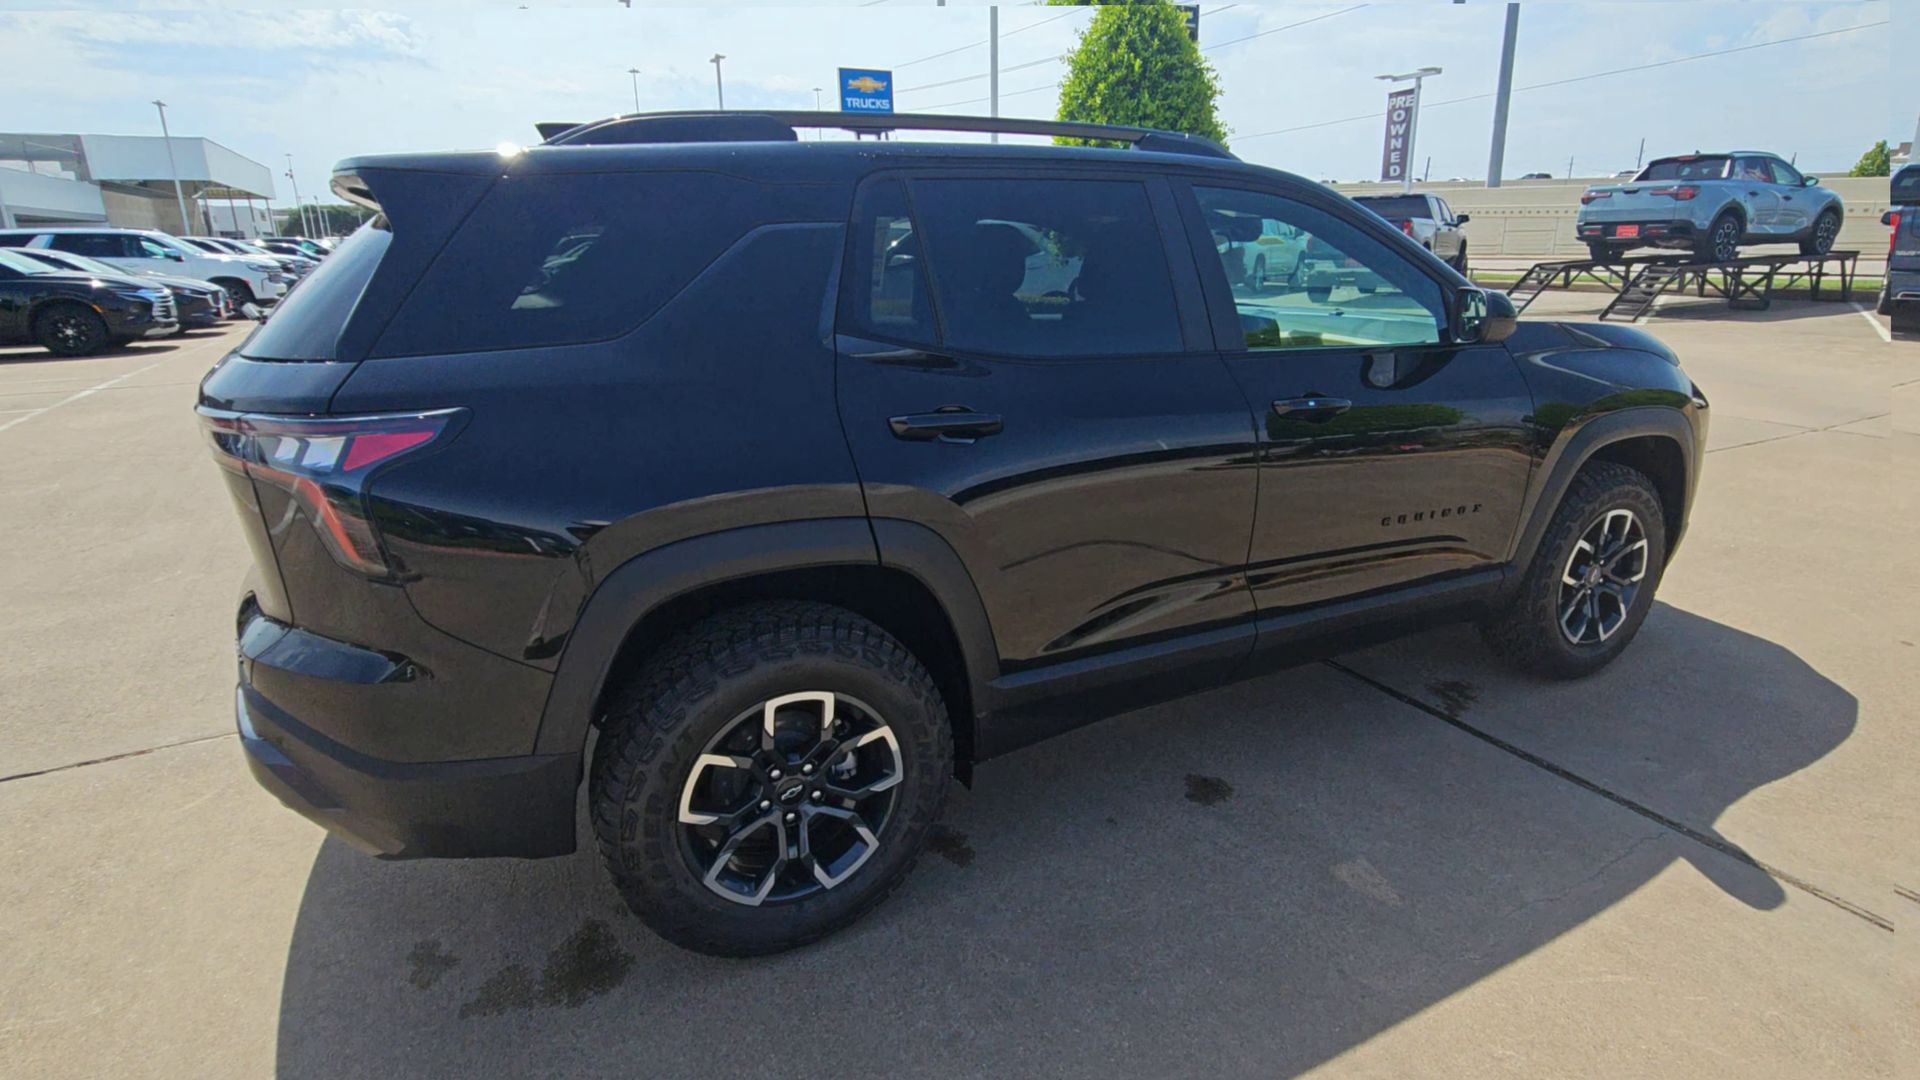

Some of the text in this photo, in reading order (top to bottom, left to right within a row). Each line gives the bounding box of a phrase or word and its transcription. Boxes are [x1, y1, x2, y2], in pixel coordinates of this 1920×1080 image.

[845, 97, 890, 109] TRUCKS
[1389, 95, 1415, 109] PRE
[1389, 110, 1406, 177] OWNED
